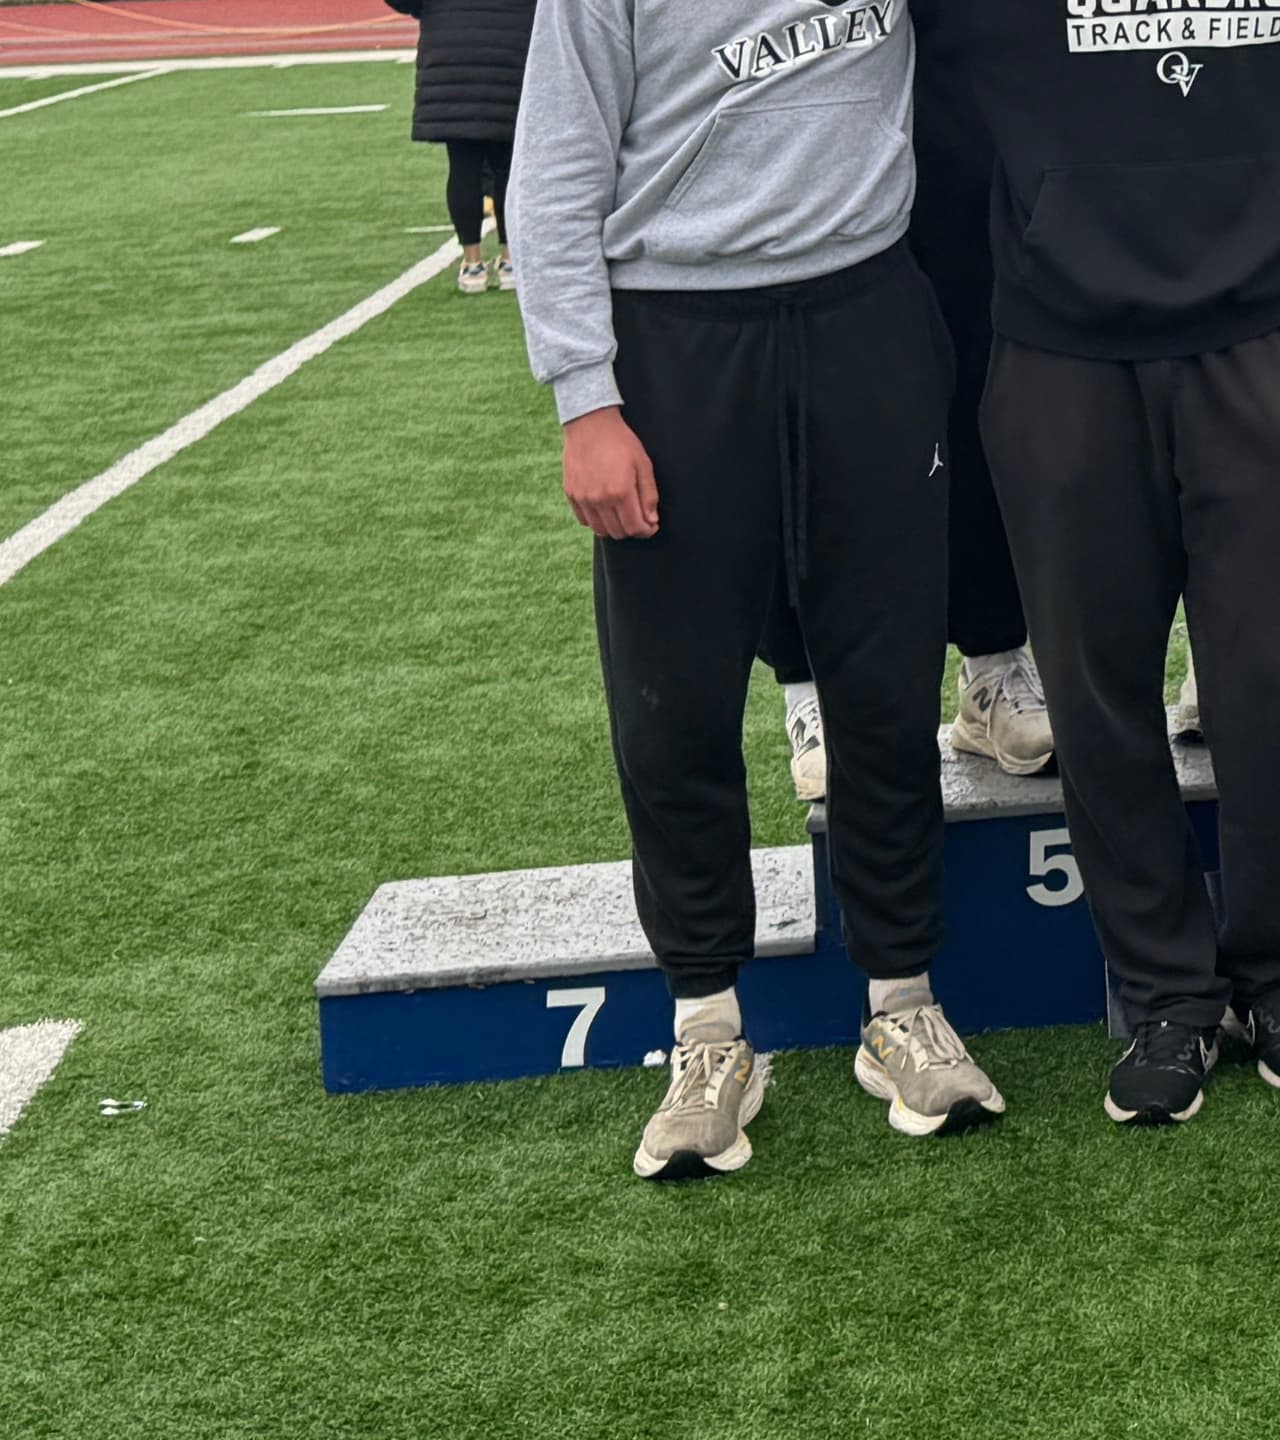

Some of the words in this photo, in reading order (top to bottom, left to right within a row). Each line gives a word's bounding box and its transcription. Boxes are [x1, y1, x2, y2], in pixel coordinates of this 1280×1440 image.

[712, 0, 895, 80] VALLEY
[1071, 17, 1172, 47] TRACK
[1182, 17, 1196, 41] &
[1156, 50, 1204, 98] QV
[1026, 828, 1084, 908] 5
[546, 986, 606, 1067] 7
